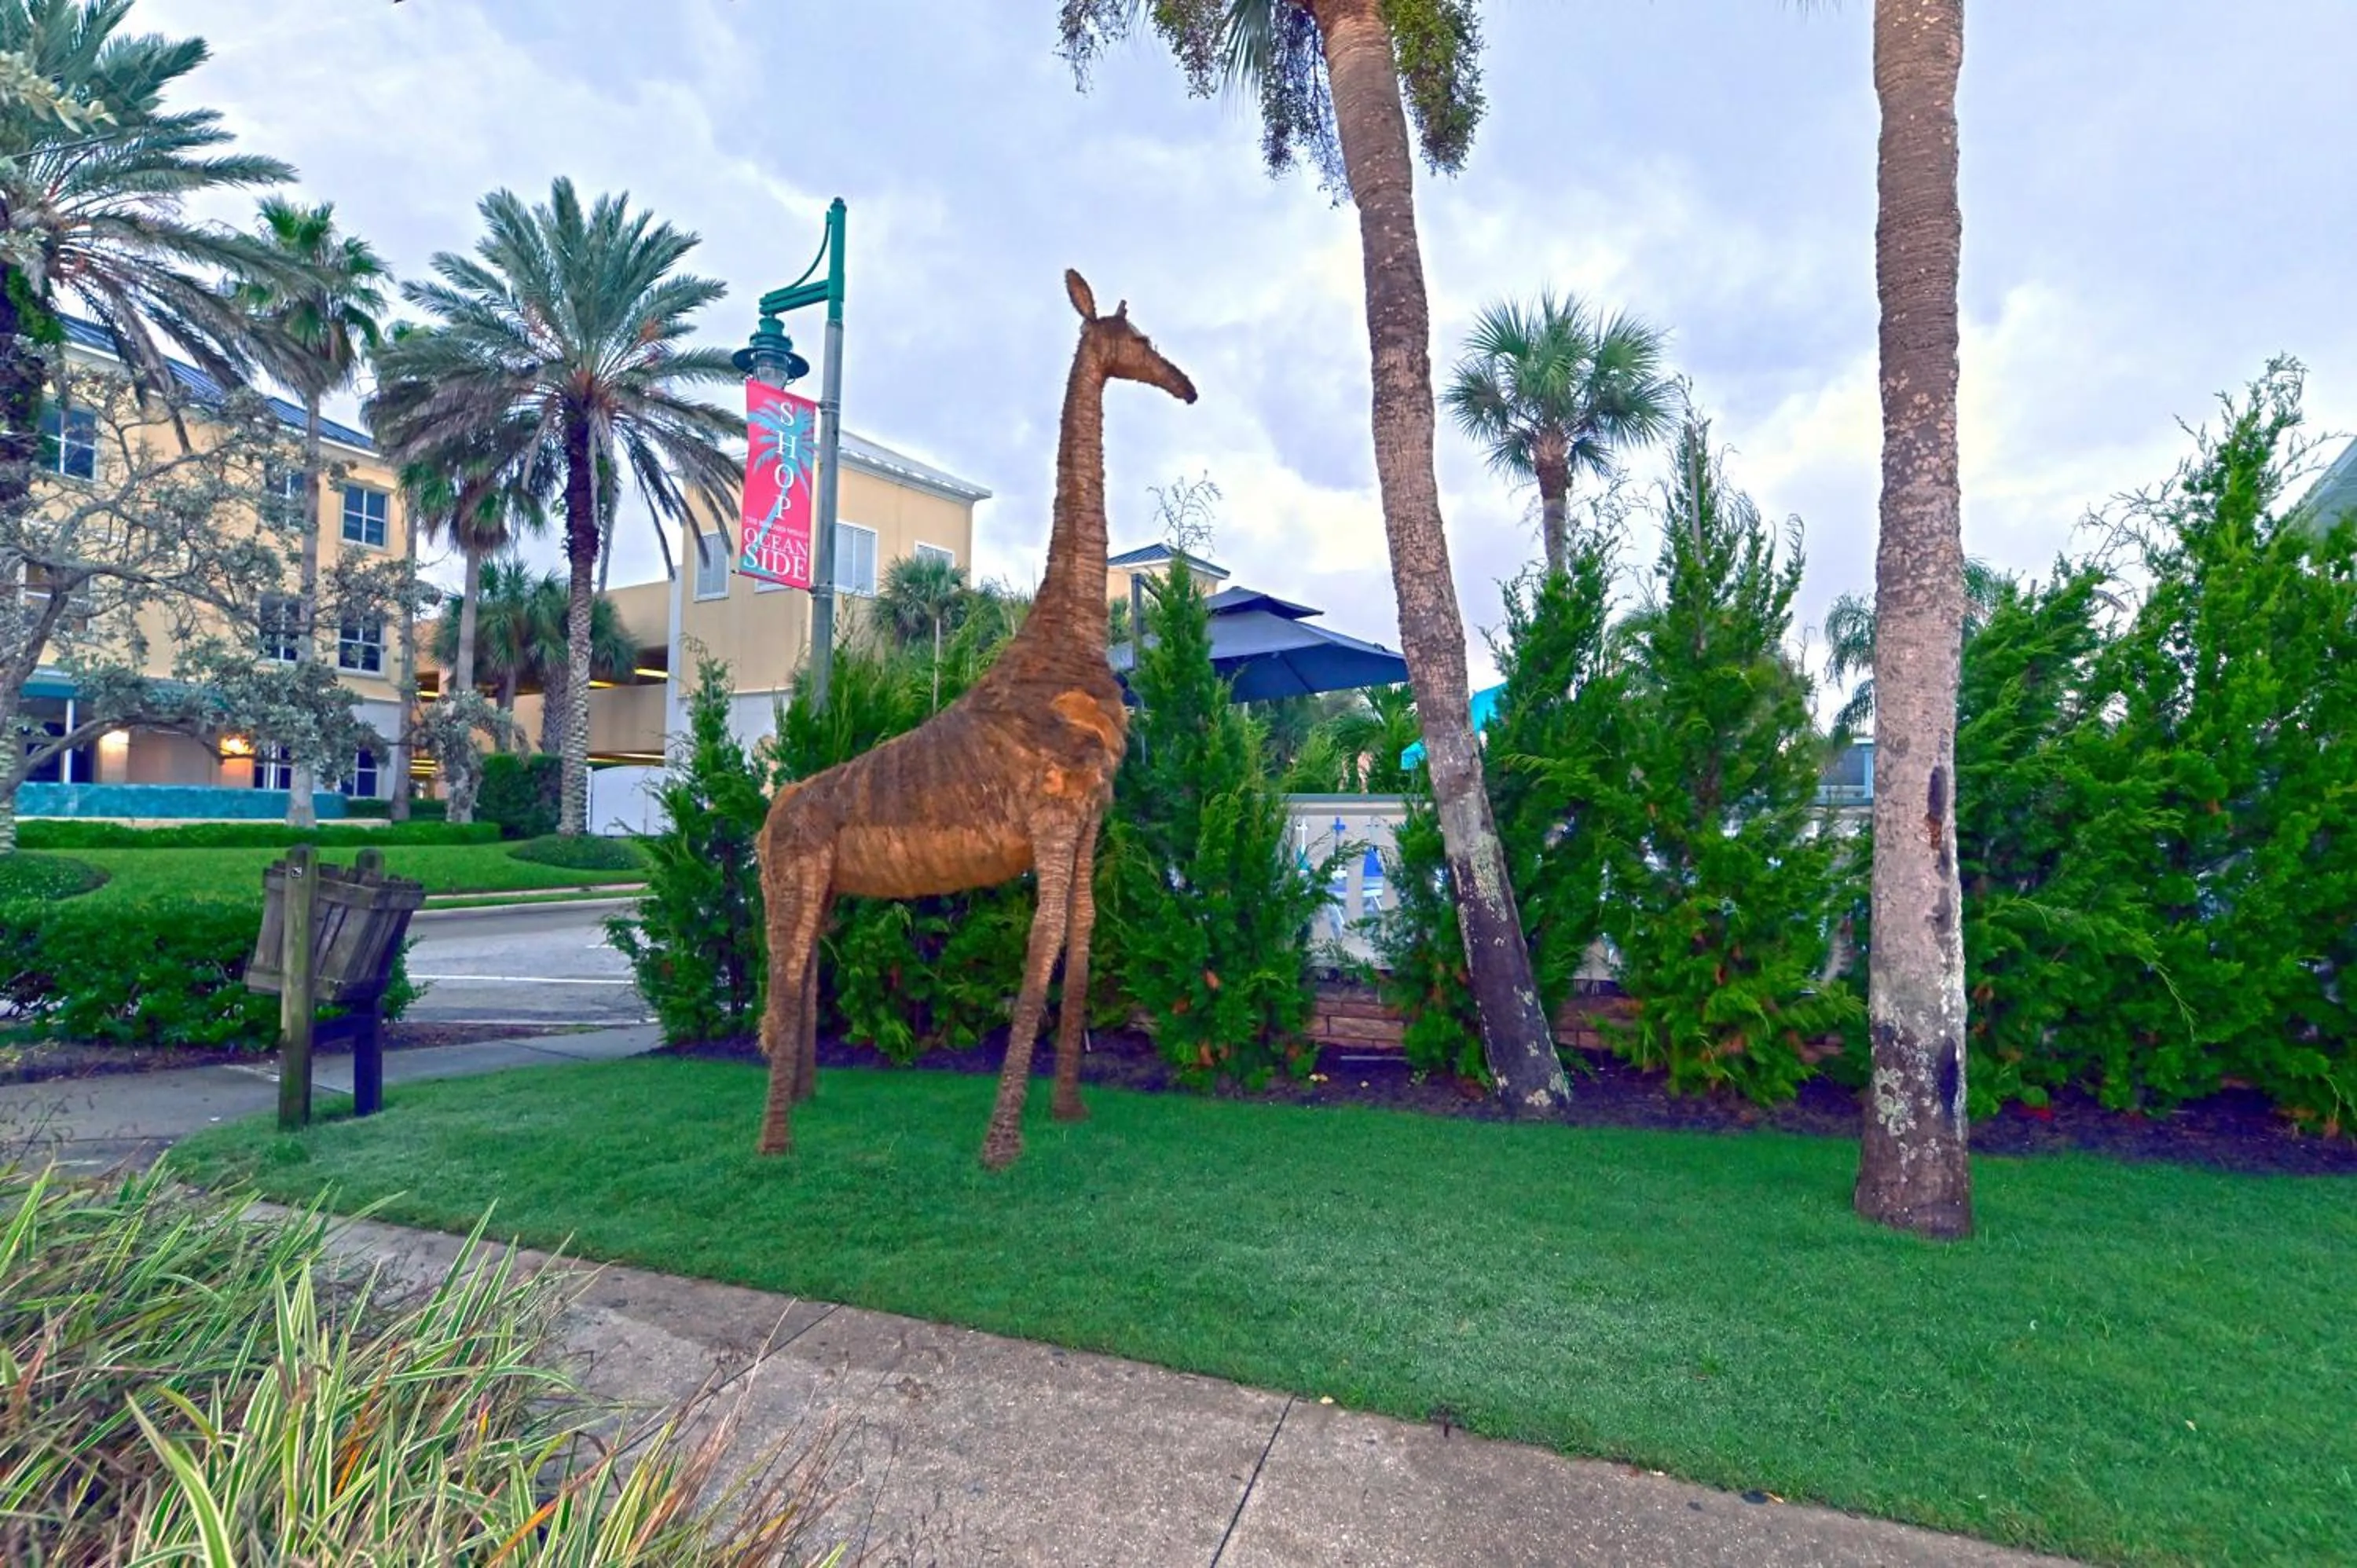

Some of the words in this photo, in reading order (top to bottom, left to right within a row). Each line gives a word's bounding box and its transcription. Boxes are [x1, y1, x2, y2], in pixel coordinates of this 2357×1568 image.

[774, 401, 797, 519] SHOP
[744, 527, 808, 557] OCEAN
[743, 543, 808, 581] SIDE
